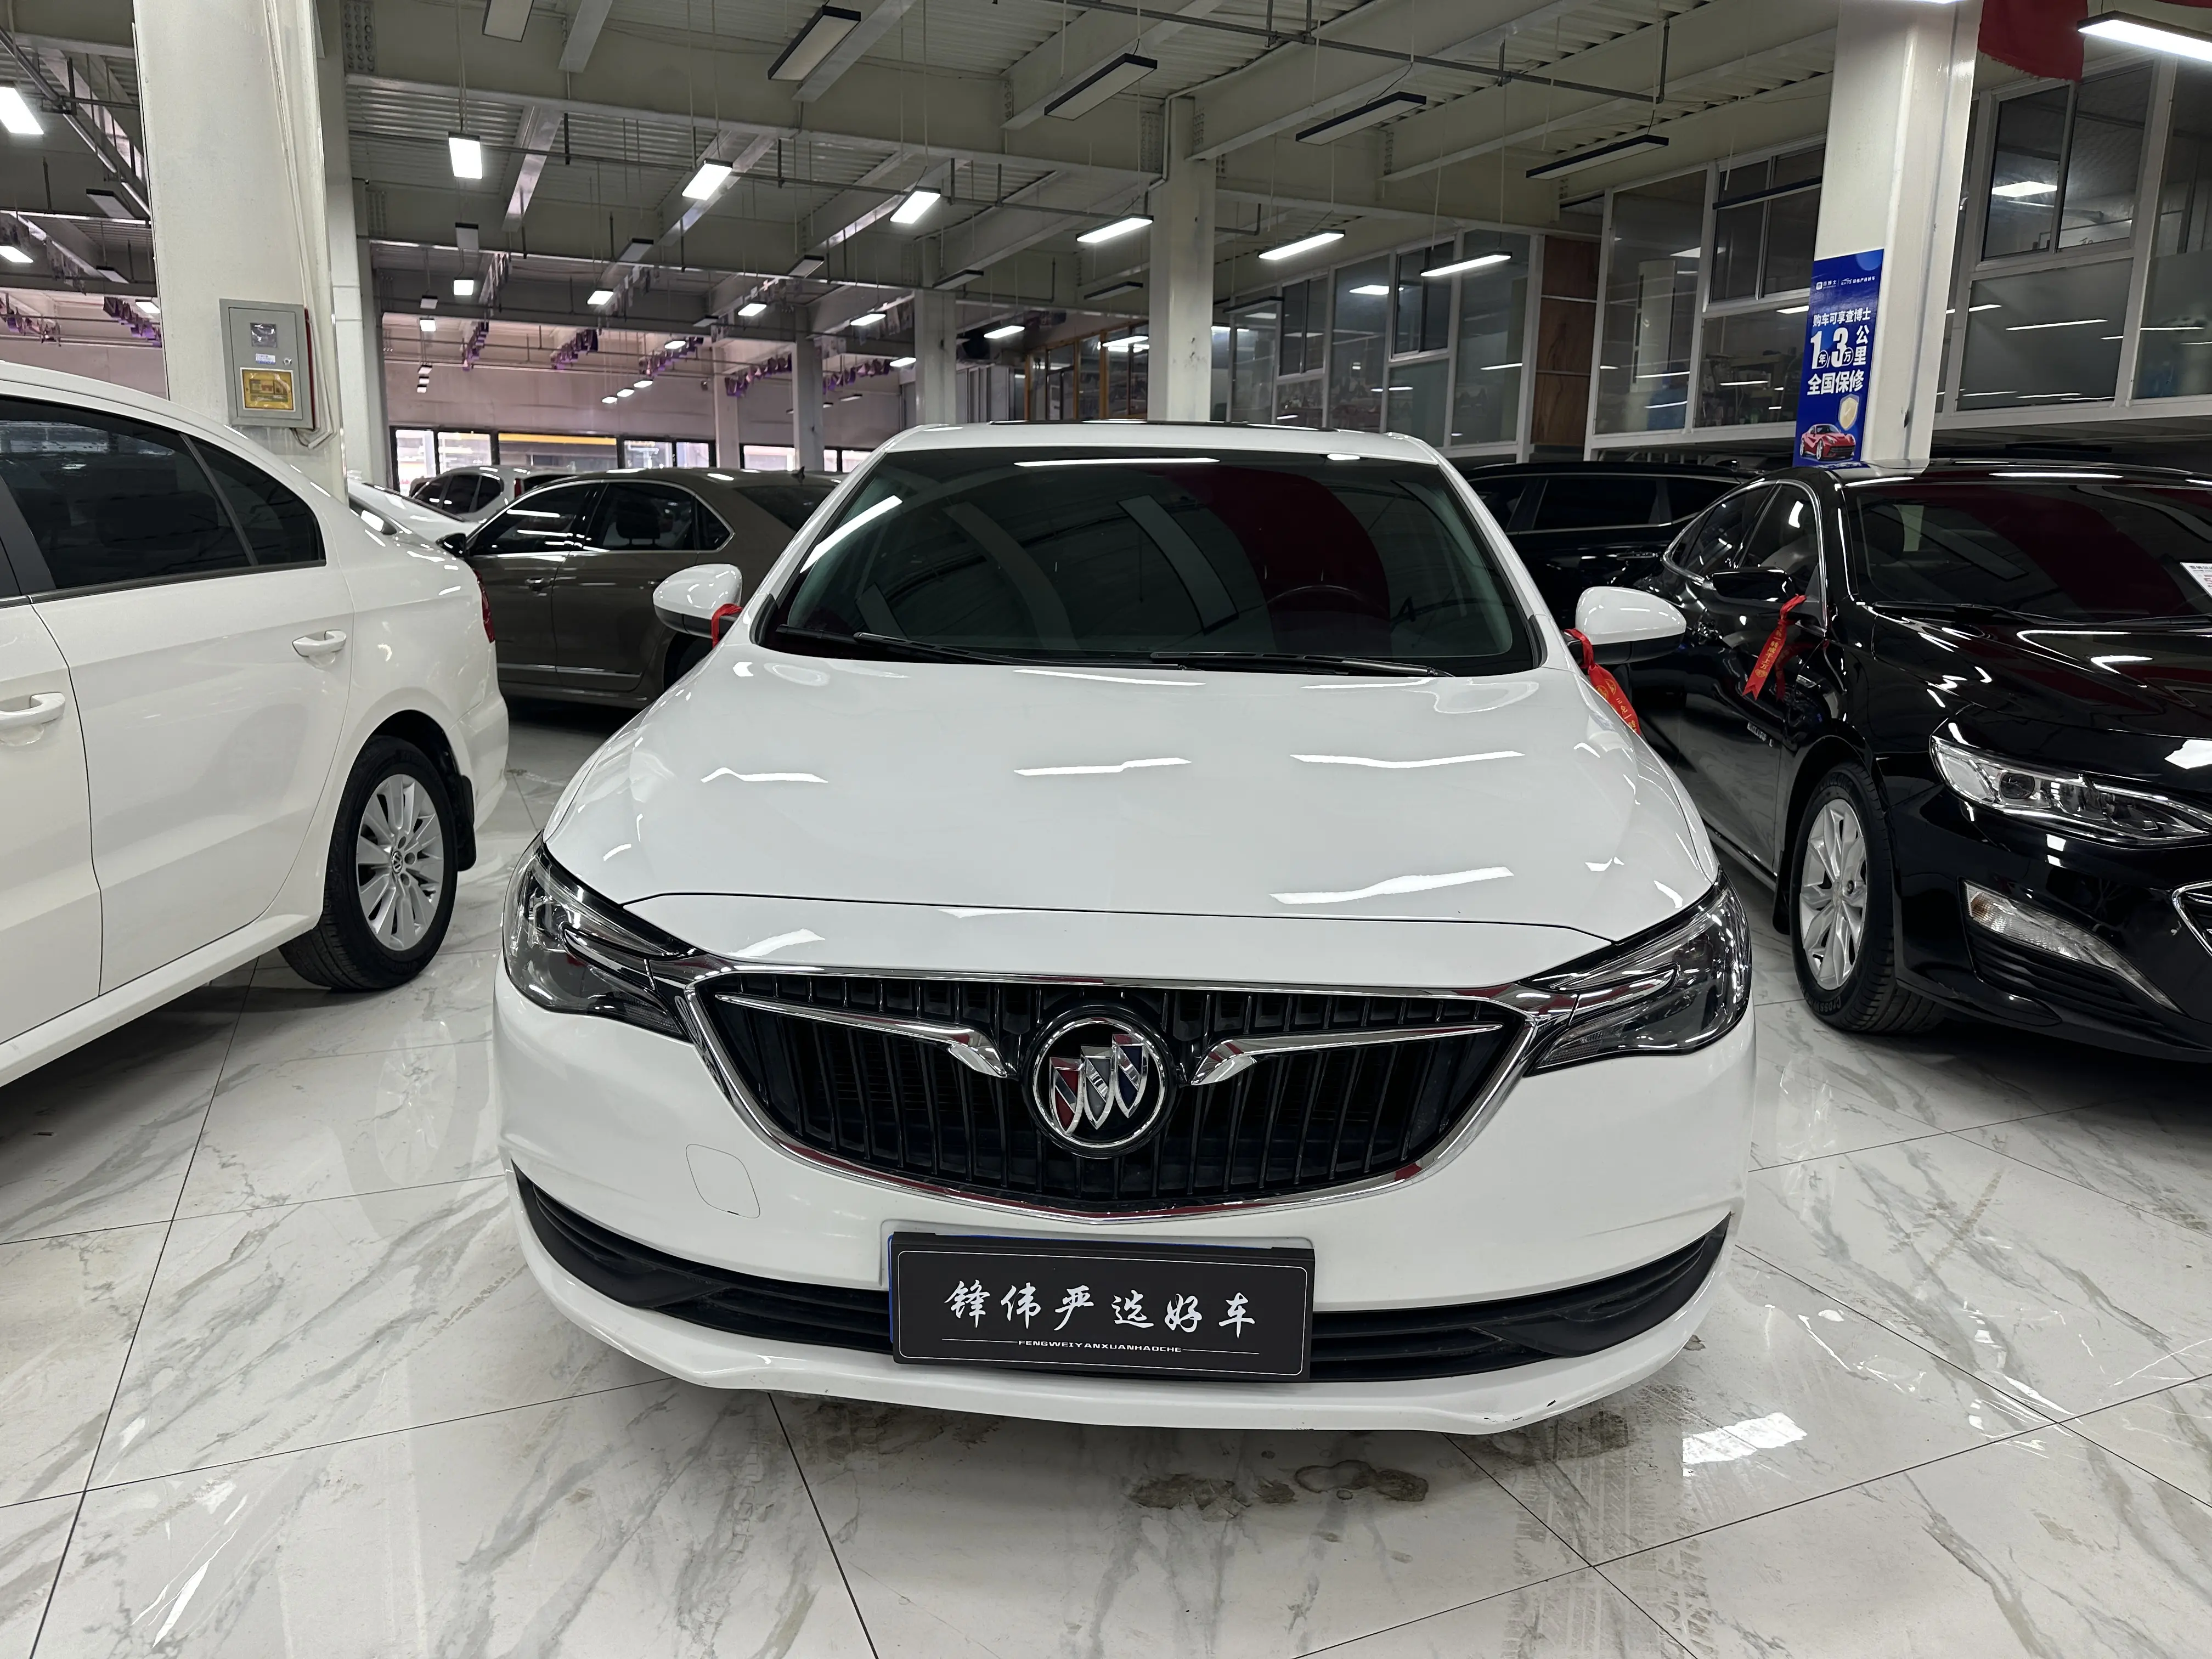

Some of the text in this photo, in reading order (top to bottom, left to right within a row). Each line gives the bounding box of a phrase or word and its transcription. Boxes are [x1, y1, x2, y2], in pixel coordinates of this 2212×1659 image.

[1813, 307, 1871, 328] 购车可享查博士
[1807, 369, 1865, 396] 全国保修
[944, 1279, 1256, 1339] 锋伟严选好车
[1018, 1340, 1183, 1353] FENGWEIYANXUANHAOCHE
